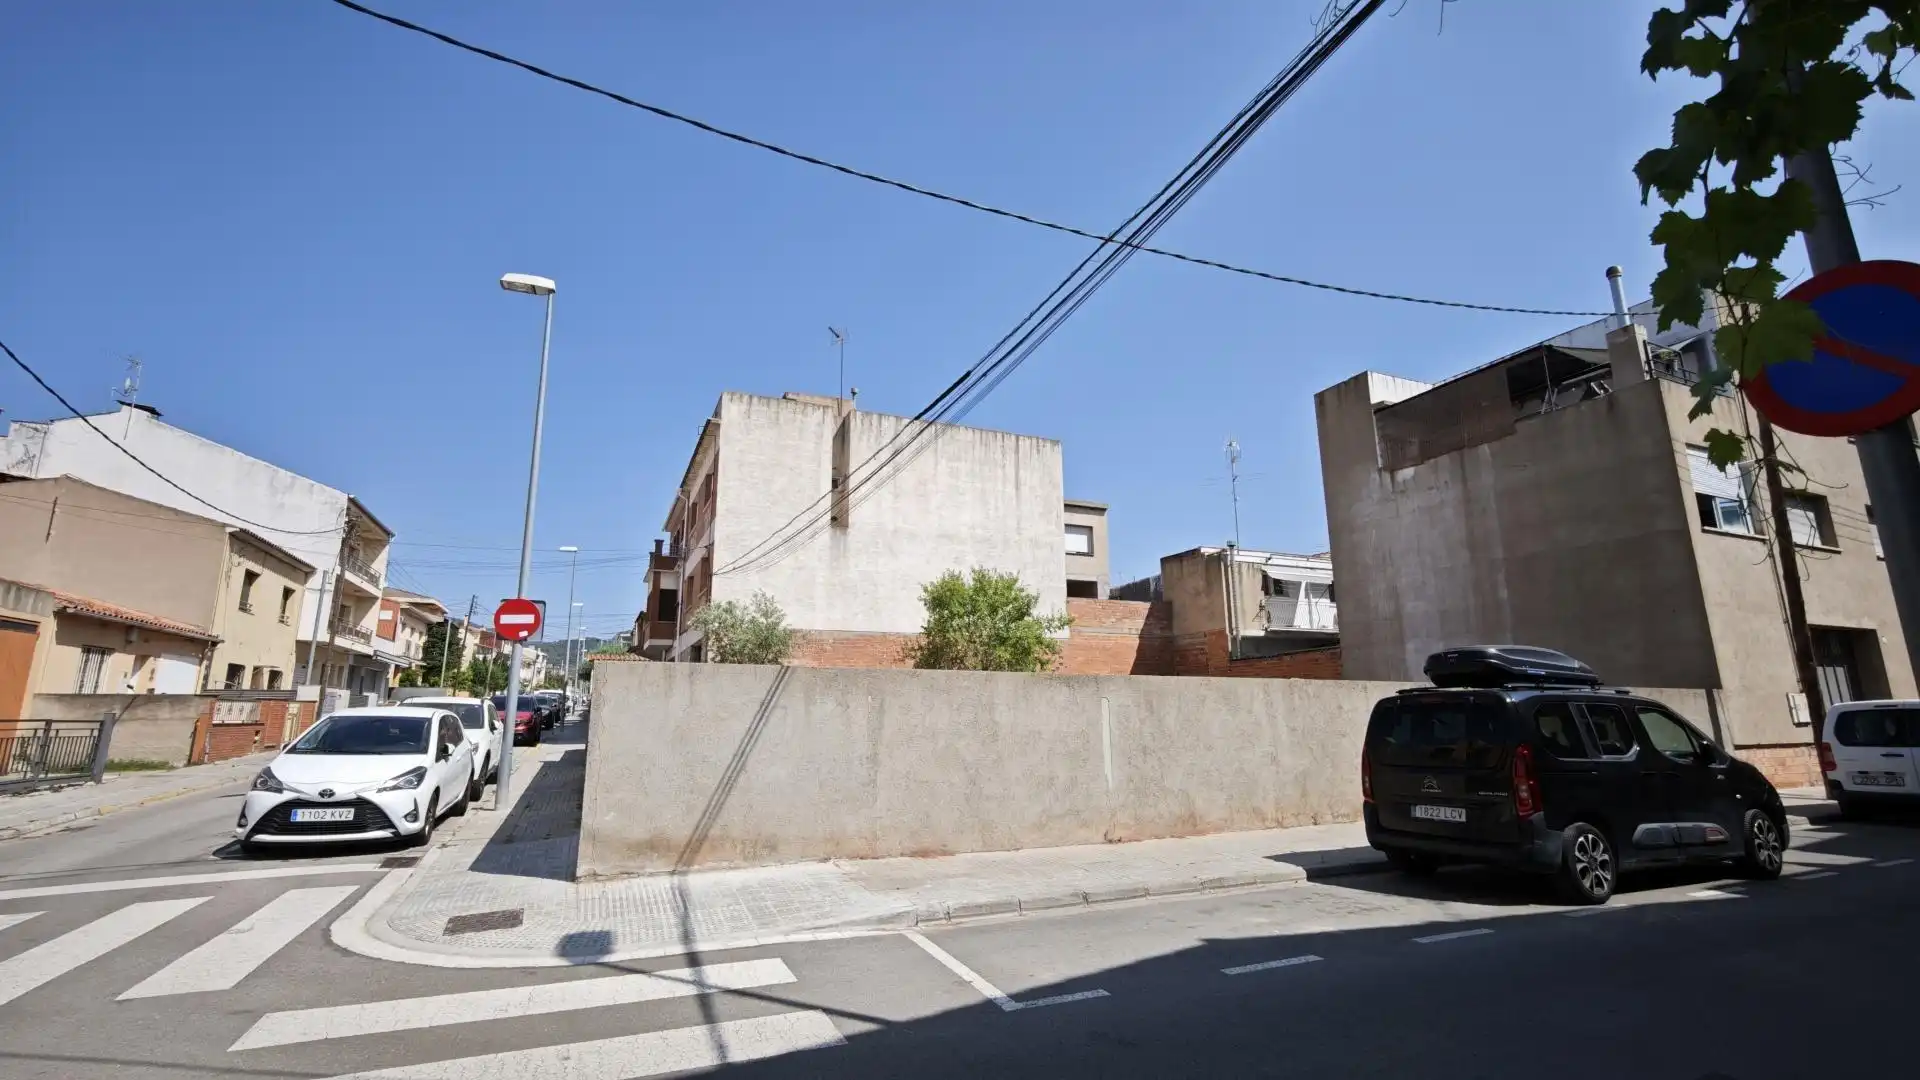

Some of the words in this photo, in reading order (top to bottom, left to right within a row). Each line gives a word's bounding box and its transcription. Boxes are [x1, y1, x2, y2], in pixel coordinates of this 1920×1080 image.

[301, 811, 327, 820] 1102
[331, 810, 351, 819] KVZ
[1419, 806, 1441, 817] 1822
[1444, 808, 1463, 819] LCV
